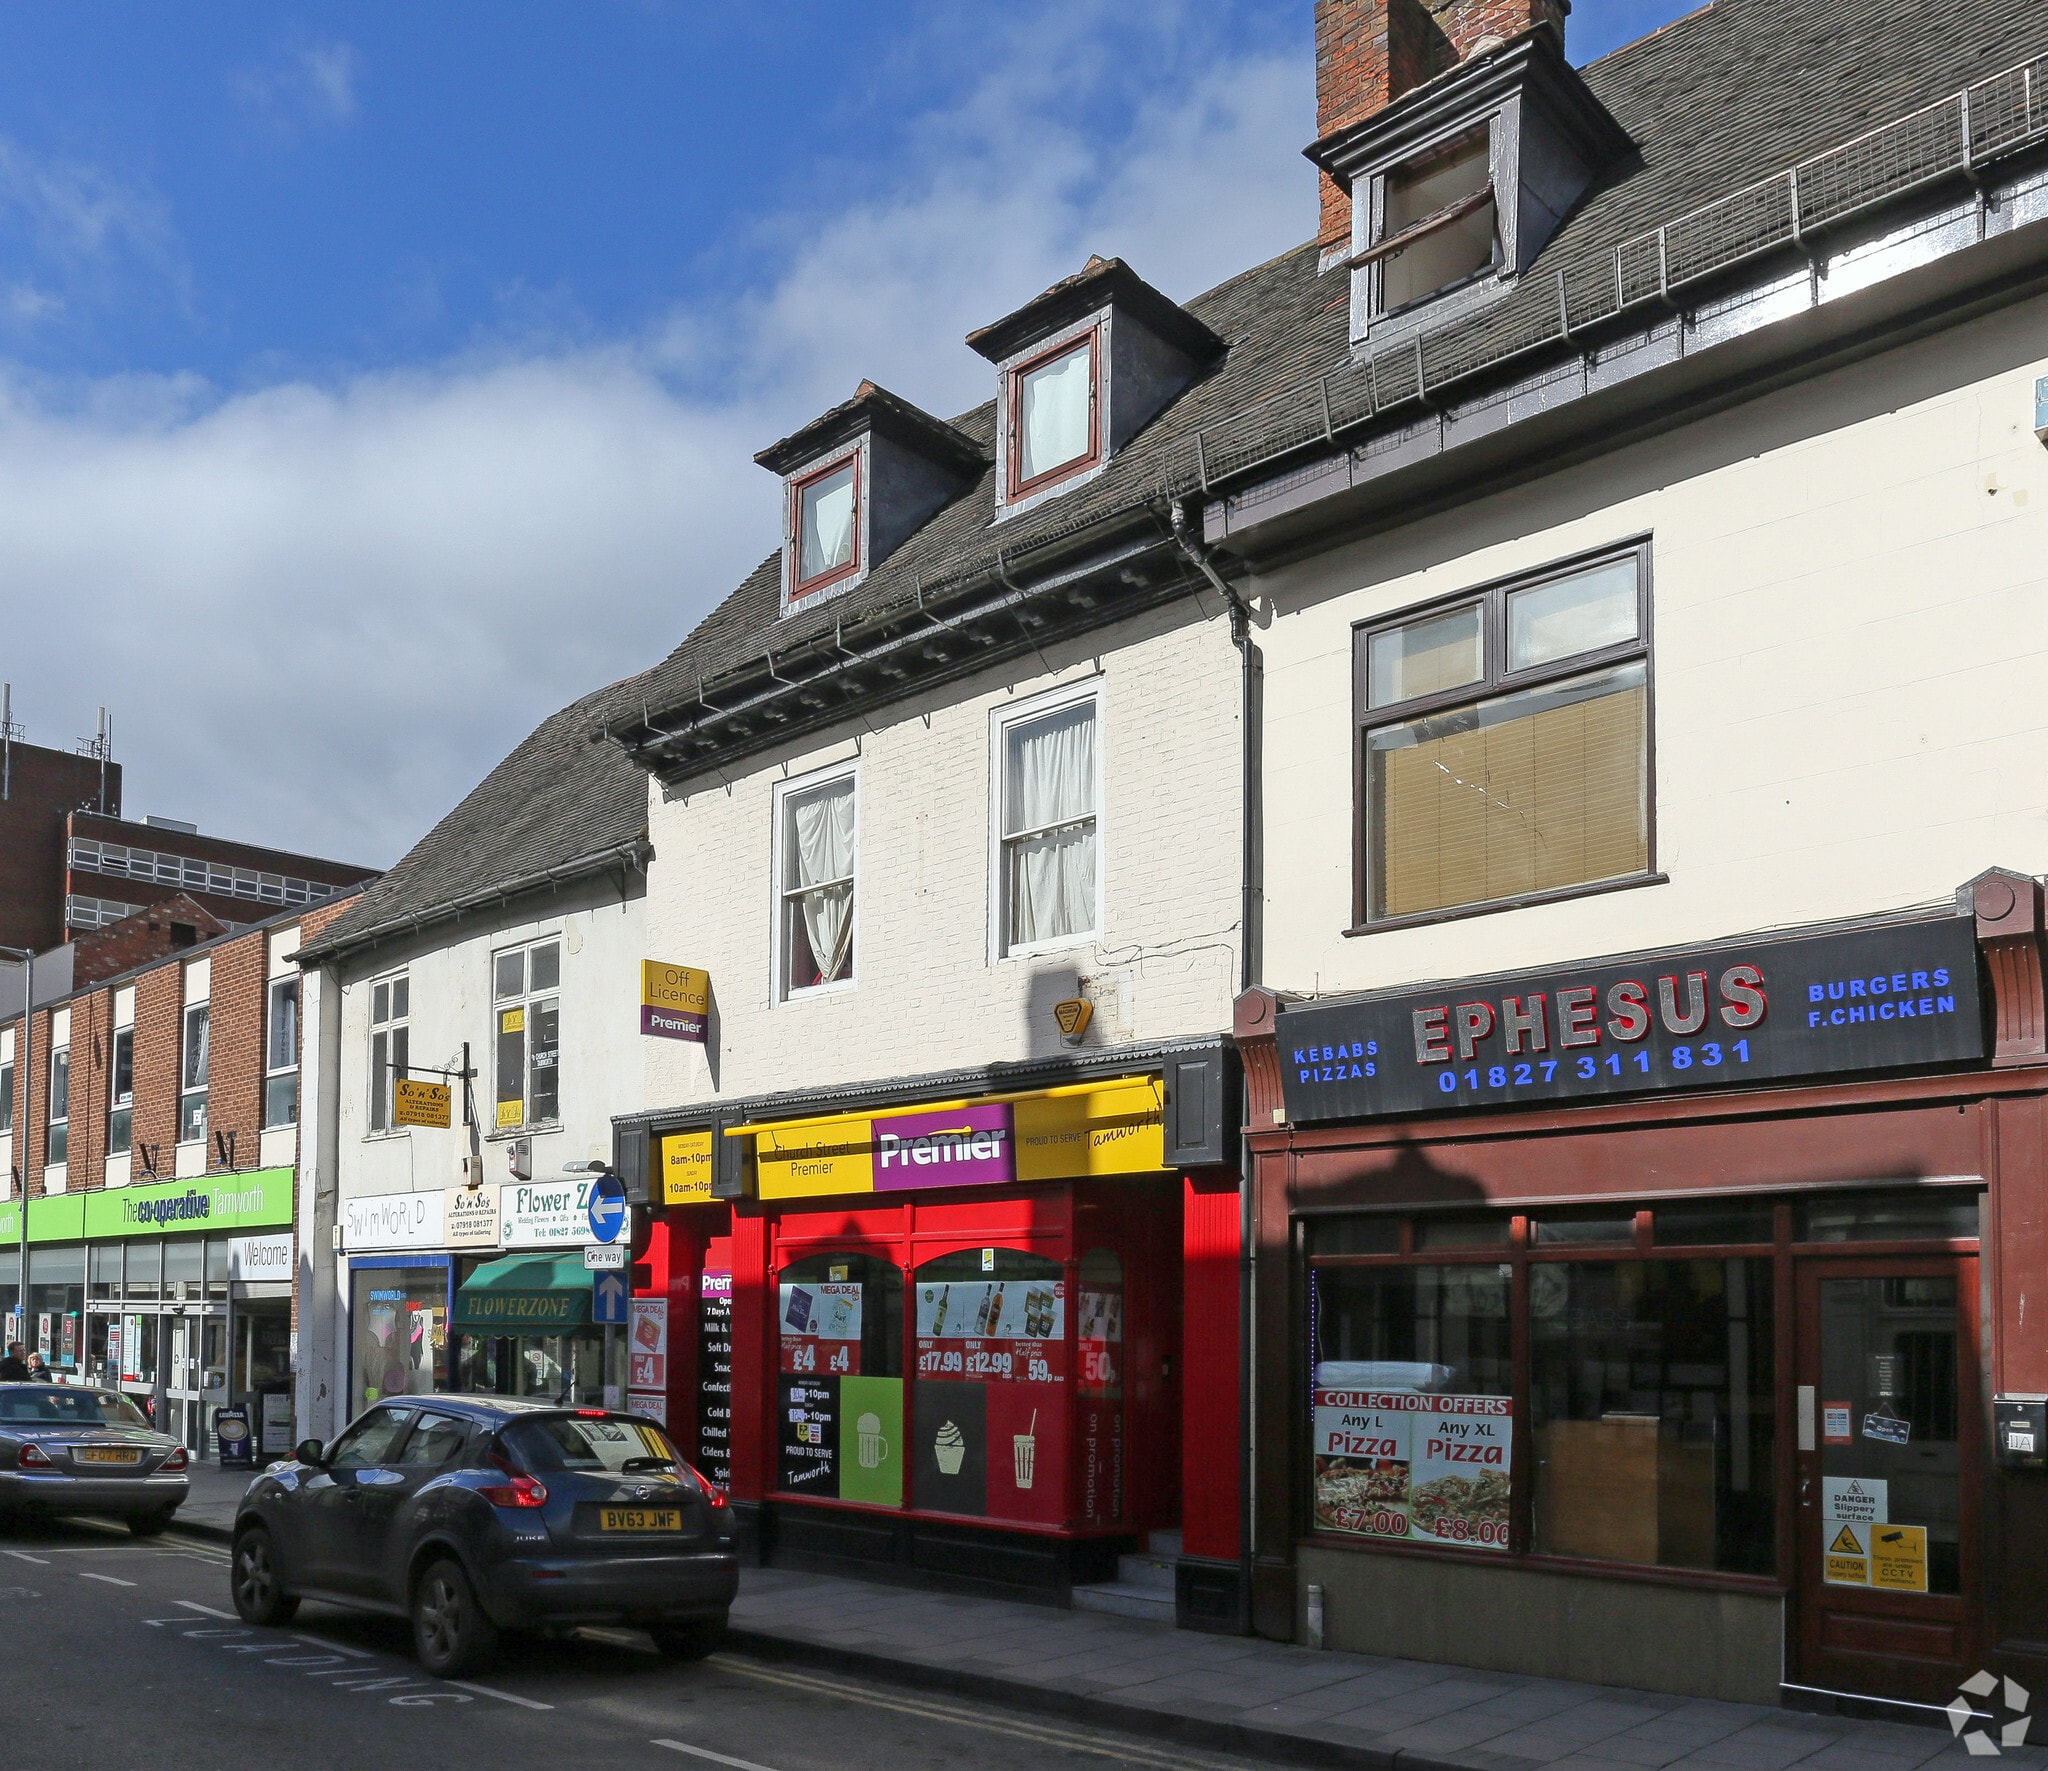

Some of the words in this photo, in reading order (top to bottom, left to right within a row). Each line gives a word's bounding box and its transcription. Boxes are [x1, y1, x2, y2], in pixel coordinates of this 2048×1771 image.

[665, 969, 690, 987] Off
[1808, 968, 1950, 1002] BURGERS
[650, 981, 705, 1006] Licence
[1411, 964, 1768, 1065] EPHESUS
[1808, 995, 1955, 1028] F.CHICKEN
[651, 1014, 702, 1034] Premier
[1294, 1041, 1378, 1064] KEBABS
[1300, 1062, 1376, 1084] PIZZAS
[1439, 1060, 1559, 1093] 01827
[1577, 1050, 1650, 1079] 311
[1672, 1039, 1750, 1070] 831
[404, 1099, 444, 1108] ALTERATIONS
[1026, 1135, 1048, 1147] PROUD
[1049, 1135, 1059, 1144] TO
[1059, 1132, 1082, 1143] SERVE
[1084, 1107, 1163, 1150] Tamworth
[774, 1142, 813, 1161] Church
[816, 1141, 851, 1157] Street
[879, 1126, 1006, 1169] Premier
[791, 1160, 834, 1177] Premier
[122, 1199, 138, 1223] The
[138, 1189, 210, 1228] co-operative
[212, 1184, 265, 1217] Tamworth
[516, 1187, 571, 1214] Flower
[576, 1183, 589, 1210] Z
[448, 1210, 475, 1218] ALTERATIONS
[533, 1228, 547, 1238] Tel:
[548, 1227, 569, 1236] 01827
[571, 1226, 591, 1236] 5698
[244, 1241, 288, 1267] Welcome
[586, 1251, 603, 1263] One
[605, 1252, 621, 1264] way
[369, 1290, 401, 1301] SWIMWORLD
[820, 1286, 841, 1295] MEGA
[841, 1285, 860, 1295] DEAL
[468, 1297, 570, 1317] FLOWERZONE
[633, 1304, 650, 1314] MEGA
[650, 1305, 665, 1314] DEAL
[706, 1308, 711, 1316] 7
[711, 1307, 725, 1317] Days
[704, 1322, 719, 1333] Milk
[721, 1322, 728, 1333] &
[707, 1341, 722, 1353] Soft
[918, 1341, 933, 1349] ONLY
[965, 1341, 981, 1349] ONLY
[1015, 1341, 1031, 1349] better
[1015, 1347, 1030, 1357] Half
[793, 1344, 816, 1372] £4
[830, 1345, 849, 1372] £4
[919, 1351, 963, 1372] £17.99
[966, 1352, 1012, 1374] £12.99
[637, 1357, 655, 1384] £4
[714, 1362, 732, 1374] Snac
[702, 1381, 732, 1393] Confecti
[631, 1400, 648, 1410] MEGA
[648, 1401, 663, 1410] DEAL
[1324, 1391, 1433, 1411] COLLECTION
[1439, 1397, 1508, 1415] OFFERS
[707, 1407, 724, 1418] Cold
[726, 1408, 731, 1419] B
[1341, 1413, 1371, 1429] Any
[1375, 1416, 1384, 1428] L
[1090, 1413, 1098, 1432] on
[1438, 1421, 1470, 1438] Any
[1474, 1423, 1495, 1436] XL
[1876, 1425, 1895, 1435] Open
[702, 1427, 727, 1438] Chilled
[702, 1446, 725, 1458] Ciders
[785, 1446, 805, 1456] PROUD
[806, 1447, 814, 1457] TO
[815, 1448, 833, 1459] SERVE
[1327, 1431, 1397, 1457] Pizza
[1426, 1437, 1504, 1465] Pizza
[788, 1460, 831, 1485] Tamworth
[1086, 1438, 1097, 1518] promotion
[1834, 1494, 1876, 1504] DANGER
[1834, 1503, 1876, 1514] Slippery
[1836, 1512, 1874, 1522] surface
[607, 1511, 645, 1528] BV63
[650, 1511, 675, 1528] JWF
[1335, 1506, 1408, 1536] £7.00
[514, 1535, 545, 1543] JUKE
[1434, 1517, 1510, 1546] £8.00
[1829, 1558, 1865, 1571] CAUTION
[1872, 1554, 1891, 1562] These
[1894, 1556, 1924, 1565] premises
[1882, 1567, 1914, 1578] CCTV
[141, 1616, 474, 1707] LOADING
